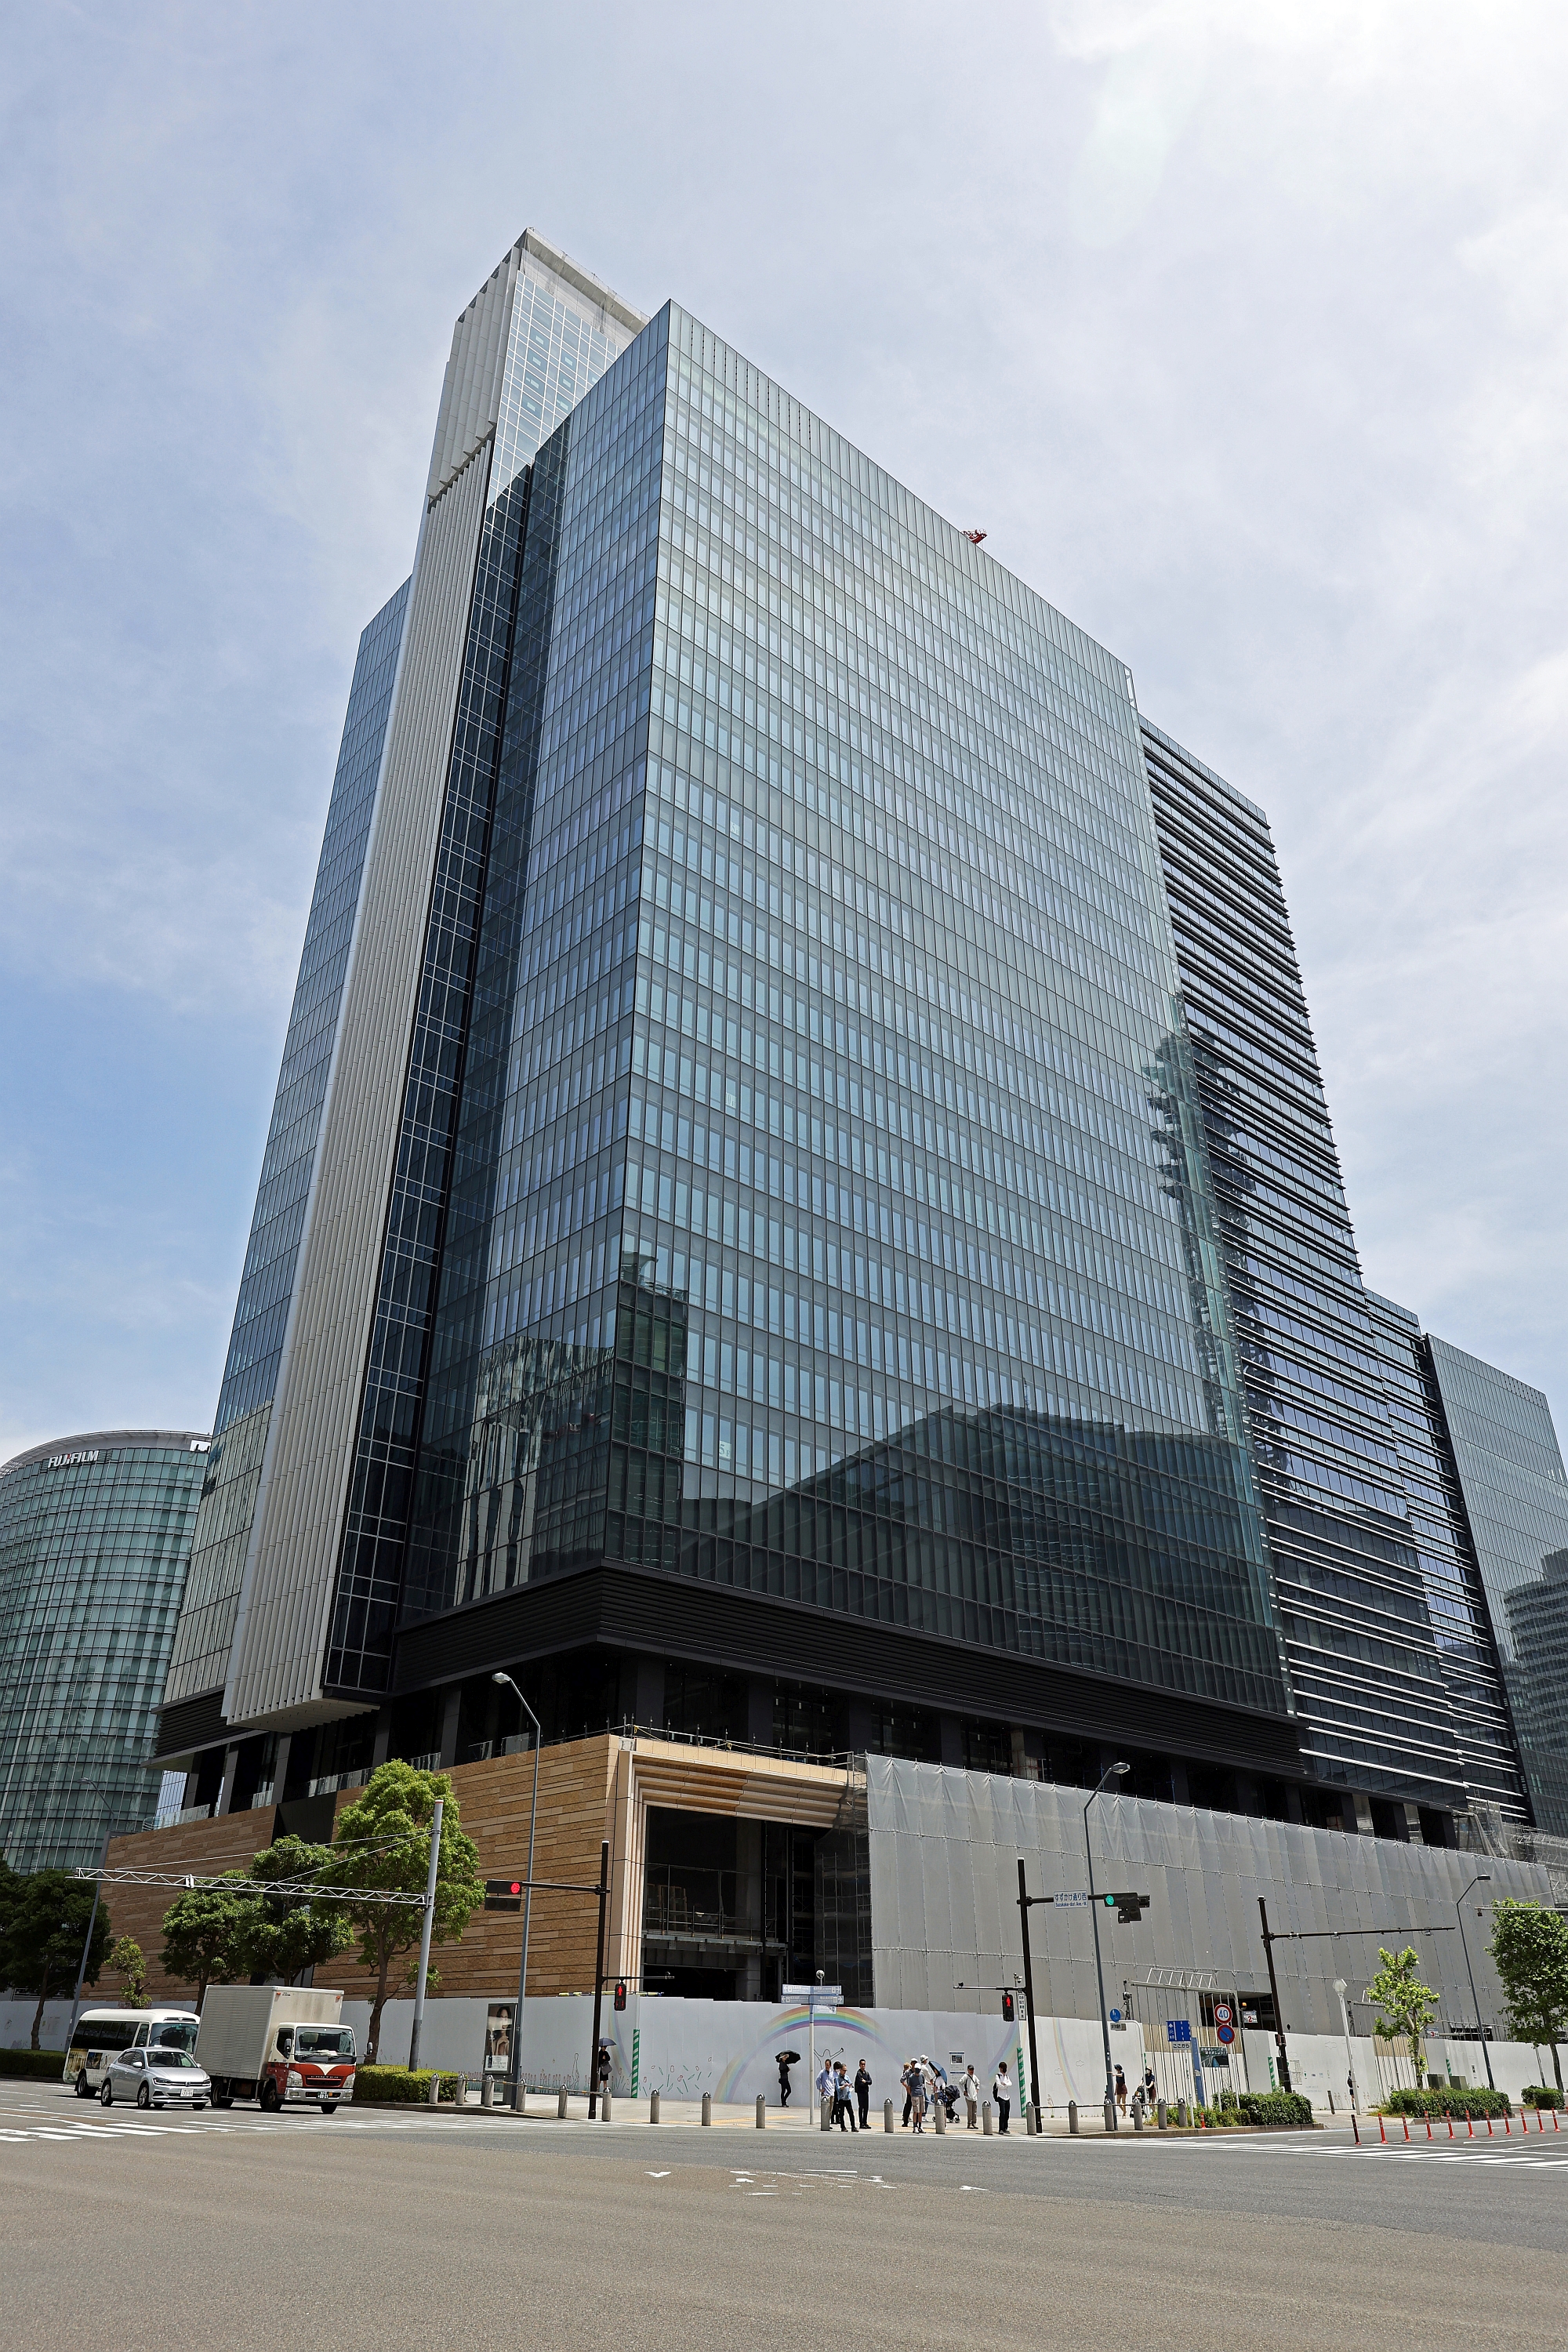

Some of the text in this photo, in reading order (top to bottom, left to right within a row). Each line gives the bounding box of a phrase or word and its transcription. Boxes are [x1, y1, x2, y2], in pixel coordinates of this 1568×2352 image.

[48, 1450, 99, 1468] FUJIFILM
[1054, 1893, 1087, 1901] すずかけ通り西
[1219, 2009, 1229, 2019] 40
